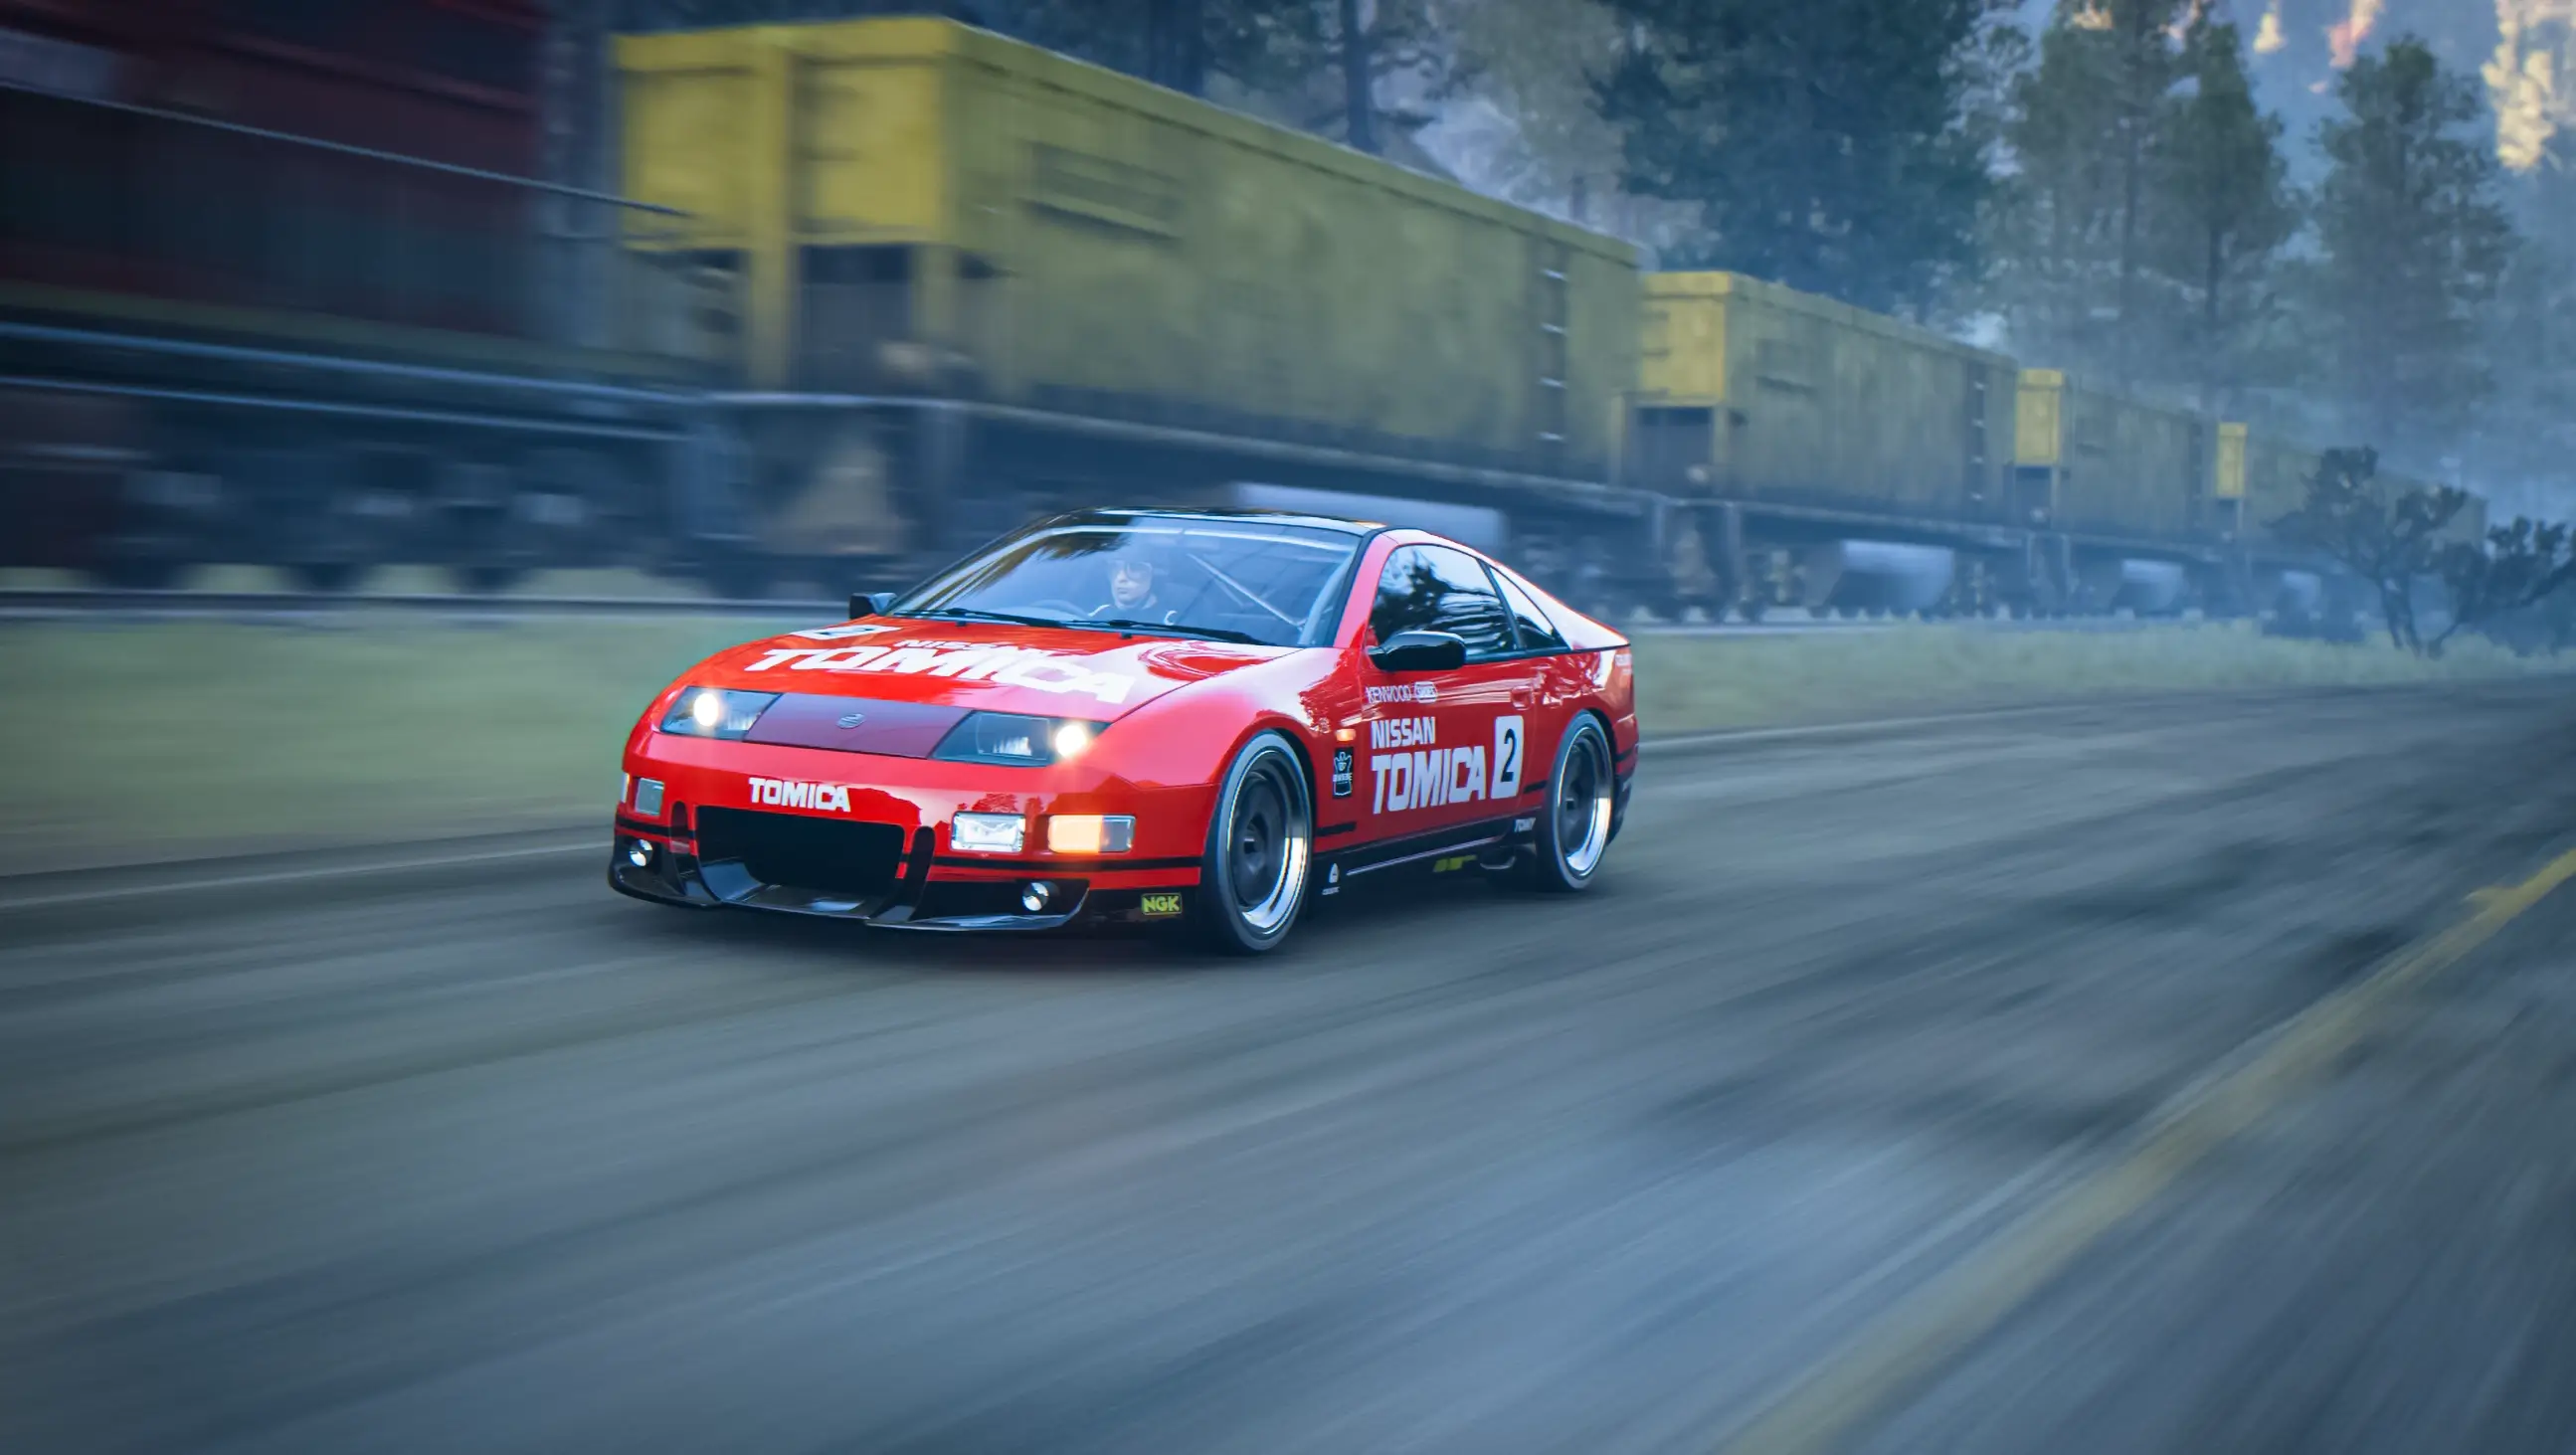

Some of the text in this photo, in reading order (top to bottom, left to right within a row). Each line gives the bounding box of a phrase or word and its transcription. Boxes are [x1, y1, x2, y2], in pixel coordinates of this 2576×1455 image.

[743, 645, 1136, 704] TOMICA
[1371, 716, 1435, 749] NISSAN
[1500, 728, 1518, 783] 2
[748, 777, 851, 813] TOMICA
[1372, 746, 1486, 815] TOMICA
[1143, 895, 1180, 913] NGK
